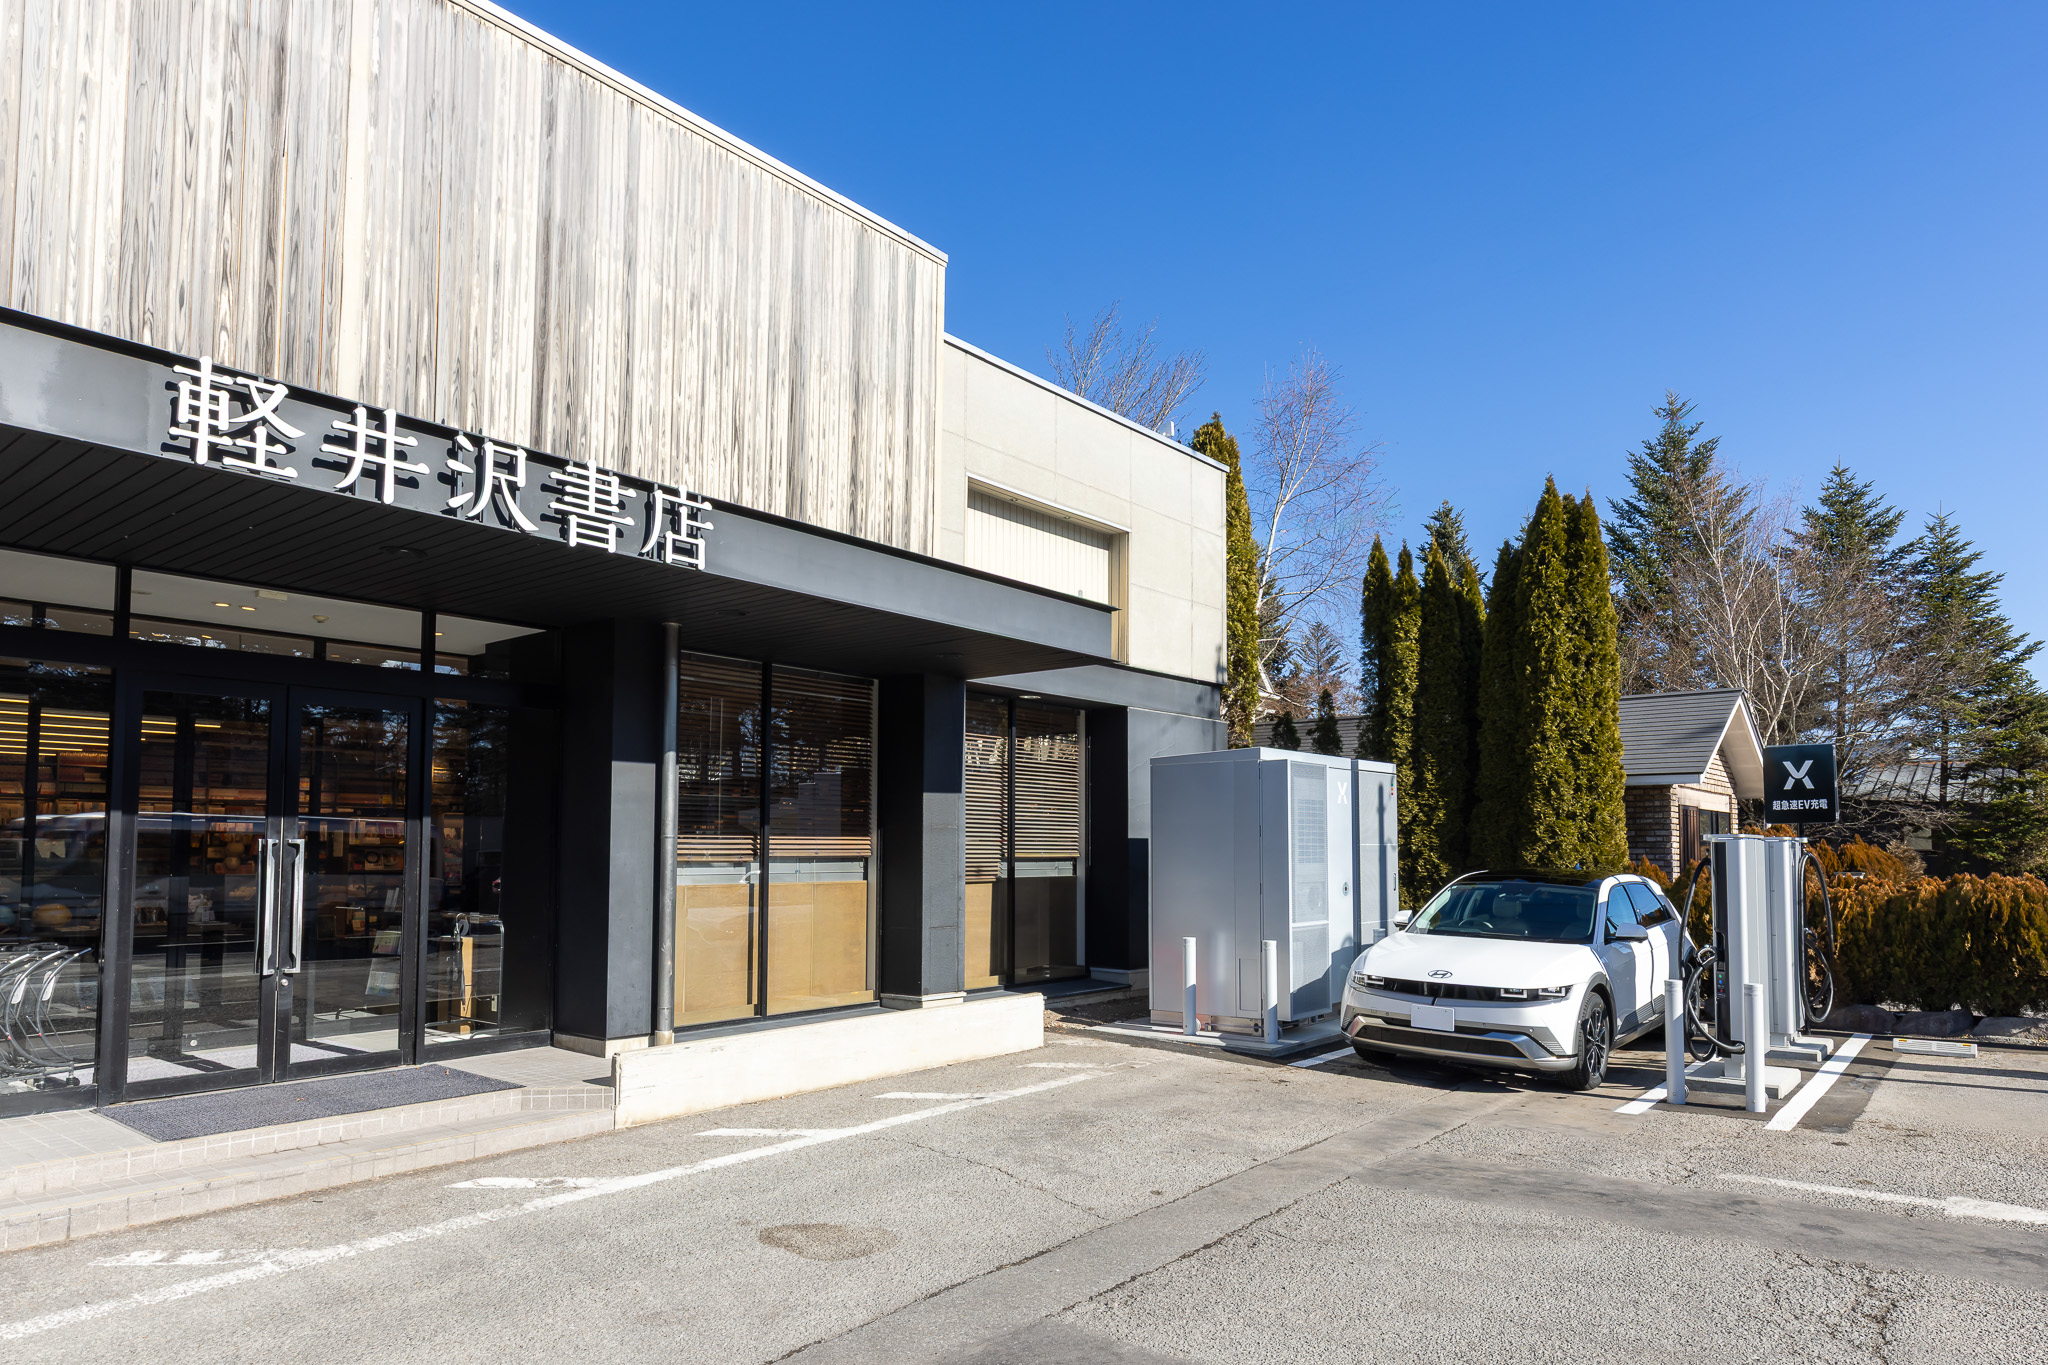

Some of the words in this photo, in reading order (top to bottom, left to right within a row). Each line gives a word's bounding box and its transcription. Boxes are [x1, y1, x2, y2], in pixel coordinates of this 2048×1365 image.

[168, 355, 714, 571] 軽井沢書店
[1772, 798, 1828, 811] 超急速EV充電
